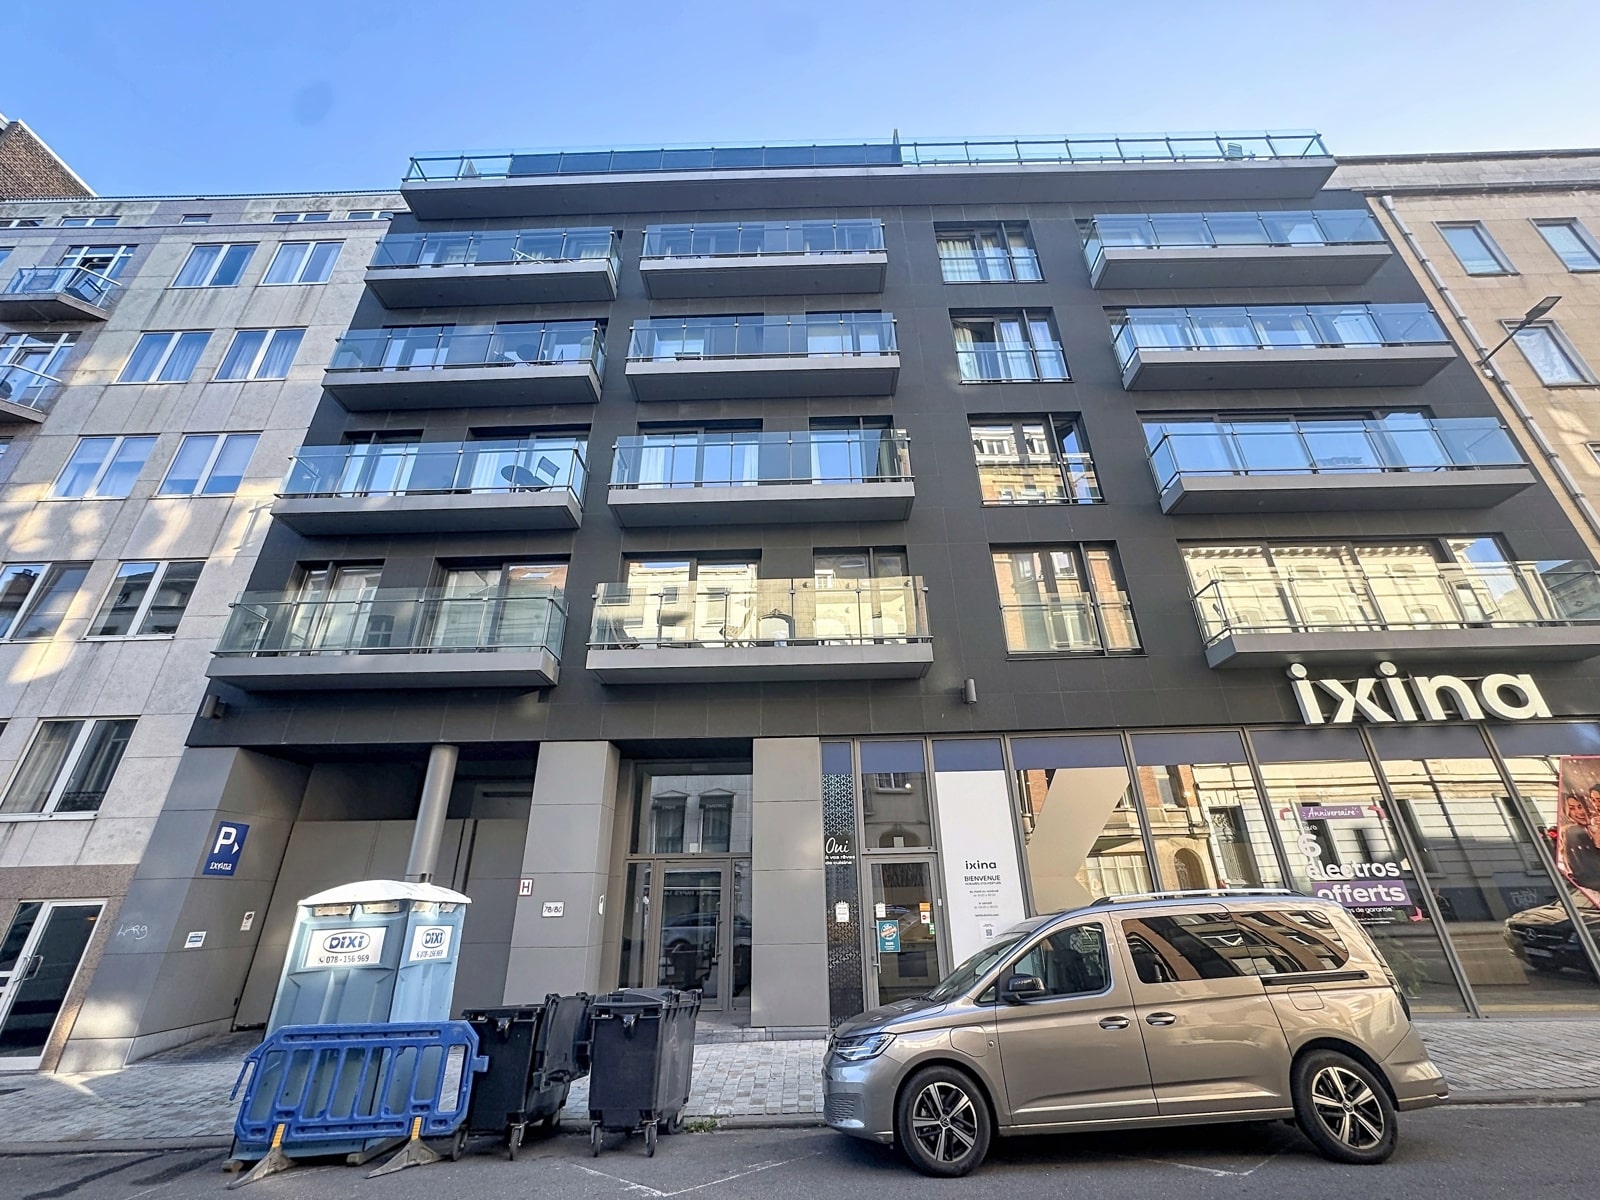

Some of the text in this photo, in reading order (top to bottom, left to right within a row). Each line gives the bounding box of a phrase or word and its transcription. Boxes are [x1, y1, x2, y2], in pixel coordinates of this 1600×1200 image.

[1287, 661, 1553, 725] ixina
[1308, 807, 1356, 818] Anniversaire
[213, 826, 237, 854] P
[825, 837, 850, 854] Oui
[1297, 833, 1321, 857] 6
[965, 860, 997, 870] ixina
[1305, 856, 1400, 881] électros
[521, 881, 531, 894] H
[1317, 884, 1405, 903] offerts
[544, 905, 563, 913] 78/80
[356, 954, 370, 963] 969
